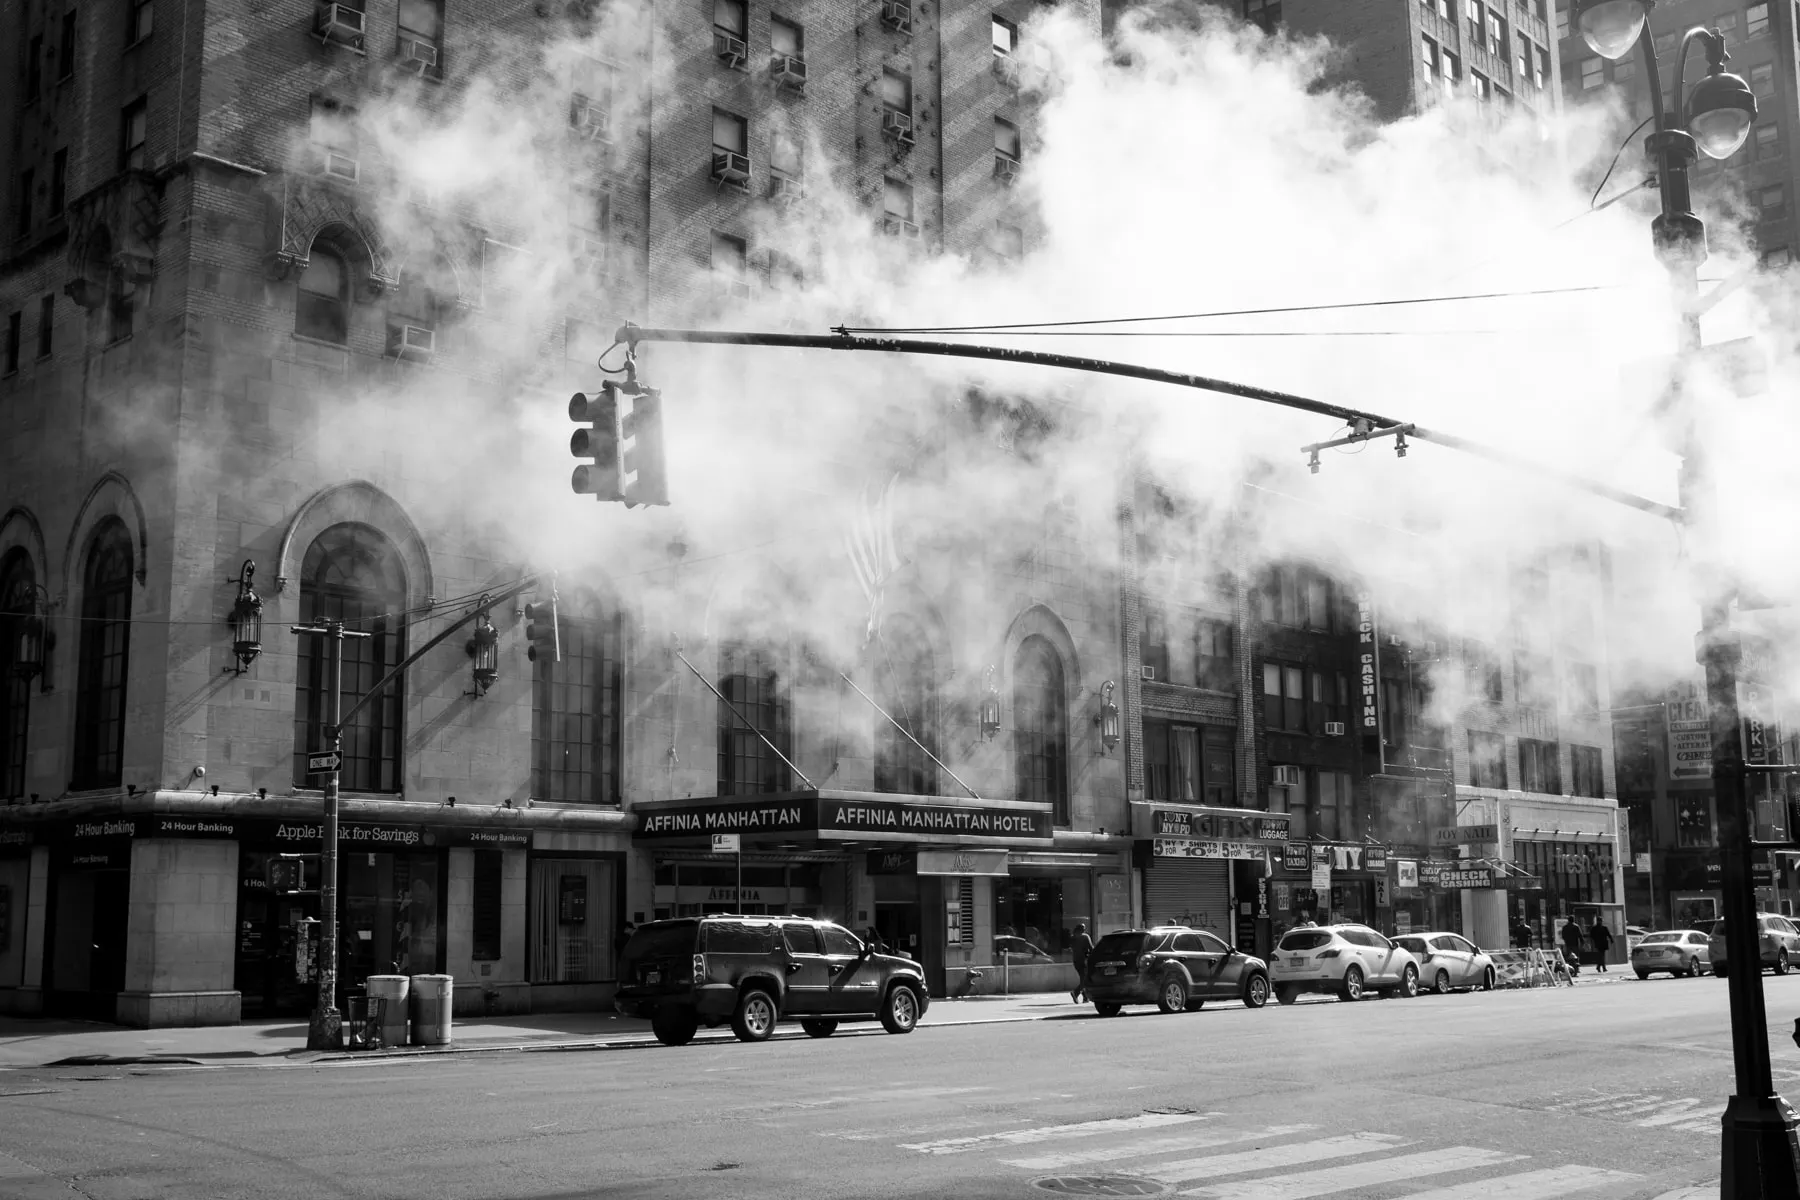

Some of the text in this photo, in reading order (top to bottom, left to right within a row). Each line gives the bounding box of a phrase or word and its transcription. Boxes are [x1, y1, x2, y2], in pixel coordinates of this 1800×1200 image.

[1358, 591, 1376, 727] CHECK CASHING
[312, 757, 337, 767] ONE WAY
[644, 807, 801, 832] AFFINIA MANHATTAN
[835, 806, 1036, 832] AFFINIA MANHATTAN HOTEL
[1174, 813, 1188, 823] NY
[75, 819, 136, 837] 24 Hour Banking
[161, 821, 234, 835] 24 Hour Banking
[276, 823, 419, 845] Apple Bnk for Savings
[1437, 828, 1493, 841] JOY NAIL
[470, 833, 480, 841] 24
[499, 834, 527, 844] Banking
[1259, 829, 1288, 841] LUGGAGE
[1154, 839, 1163, 856] 5
[1165, 847, 1176, 855] FOR
[1188, 841, 1217, 849] SHIRTS
[1221, 843, 1229, 858] 5
[1230, 849, 1241, 857] FOR
[1440, 870, 1489, 881] CHECK
[1440, 879, 1491, 888] CASHING
[1377, 881, 1385, 904] NAIL
[1279, 896, 1289, 909] OFF
